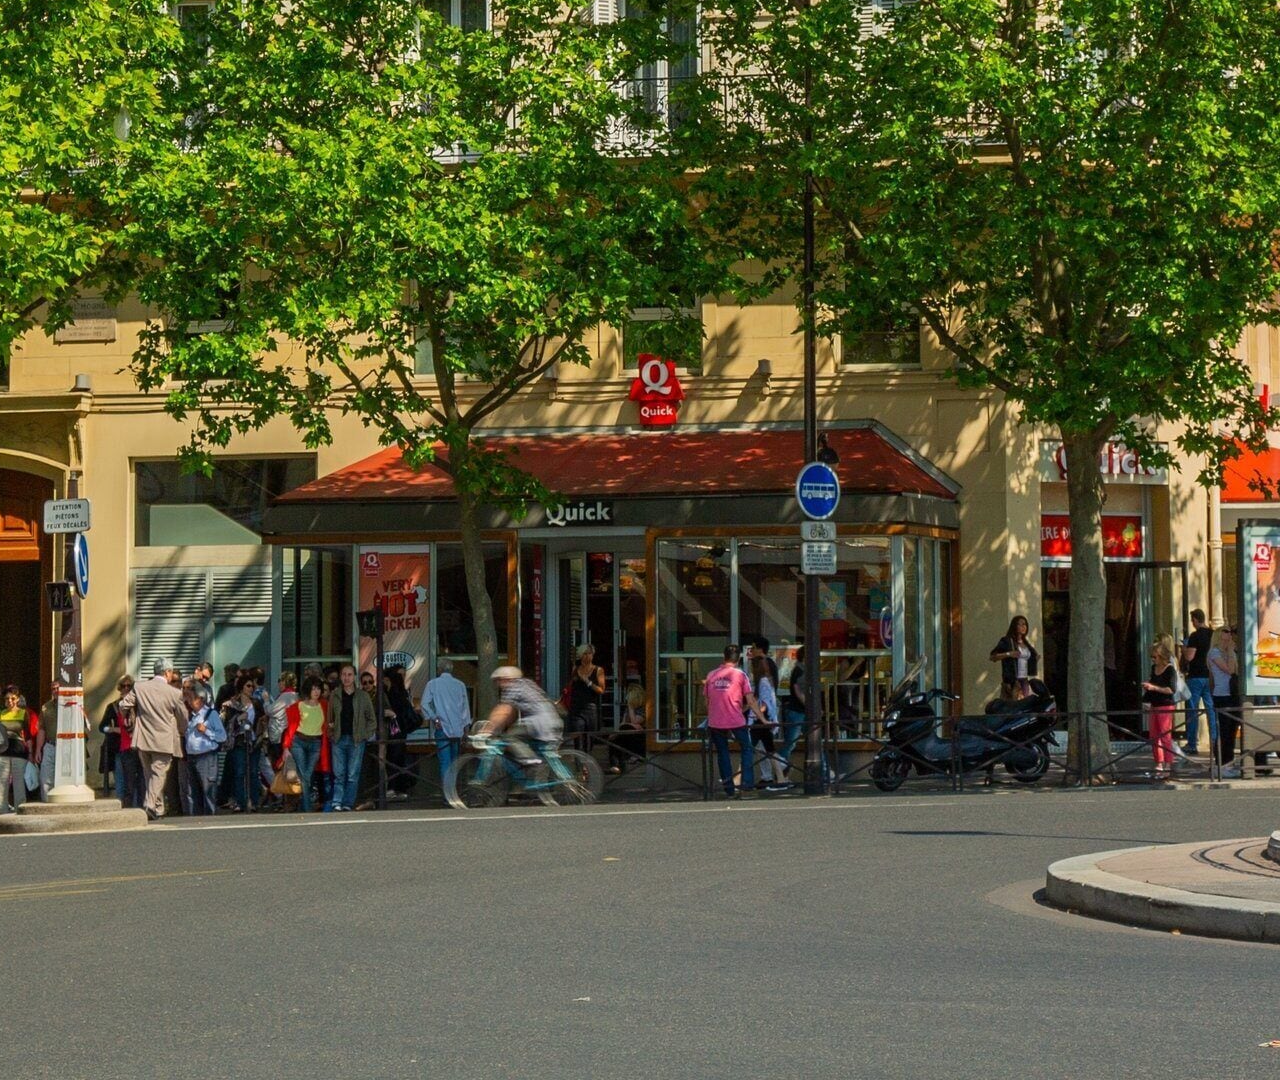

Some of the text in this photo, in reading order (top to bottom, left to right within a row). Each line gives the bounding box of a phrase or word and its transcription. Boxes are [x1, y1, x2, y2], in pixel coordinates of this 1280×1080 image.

[641, 359, 672, 395] Q
[640, 405, 674, 418] Quick
[546, 502, 611, 527] Quick
[382, 579, 412, 592] VERY
[384, 617, 421, 631] ICKEN
